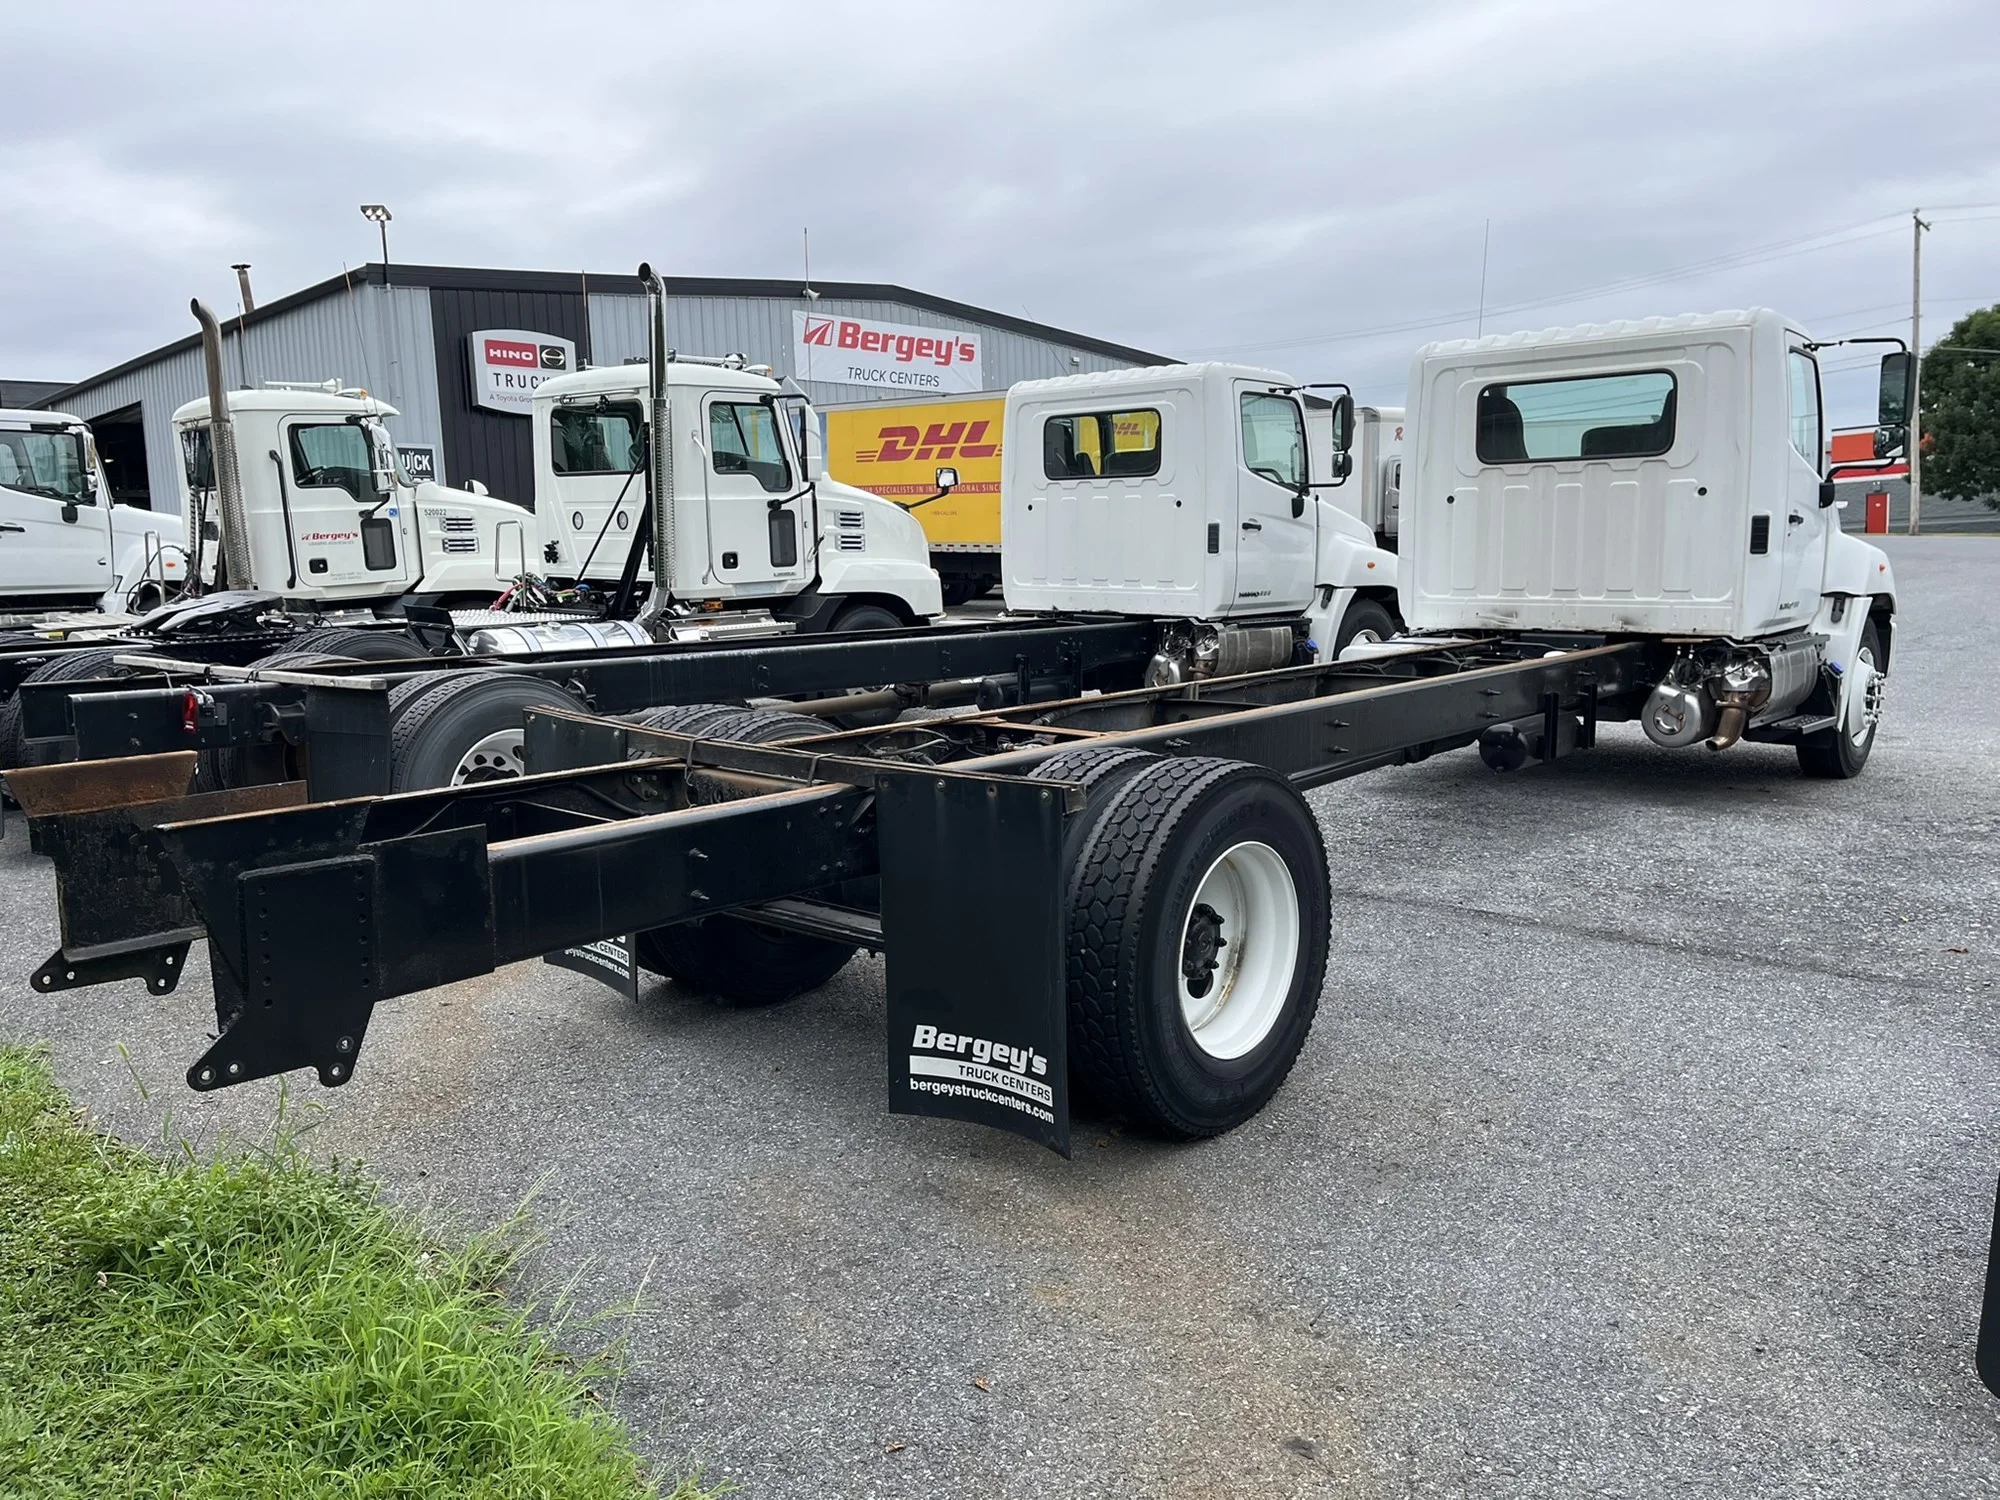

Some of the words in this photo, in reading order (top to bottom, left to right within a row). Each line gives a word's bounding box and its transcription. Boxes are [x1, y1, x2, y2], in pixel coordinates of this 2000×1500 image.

[489, 348, 534, 361] HINO
[837, 321, 975, 367] Bergey's
[847, 366, 886, 383] TRUCK
[889, 371, 940, 388] CENTERS
[496, 393, 517, 403] Toyota
[876, 420, 998, 462] DHL
[875, 485, 914, 495] SPECIALISTS
[916, 485, 924, 494] IN
[424, 508, 447, 516] 520022
[312, 531, 358, 541] Bergey's
[599, 943, 629, 964] CENTERS
[912, 1024, 1048, 1076] Bergey's
[958, 1064, 999, 1084] TRUCK
[1001, 1074, 1051, 1101] CENTERS
[909, 1077, 1055, 1124] bergeystruckcenters.com
